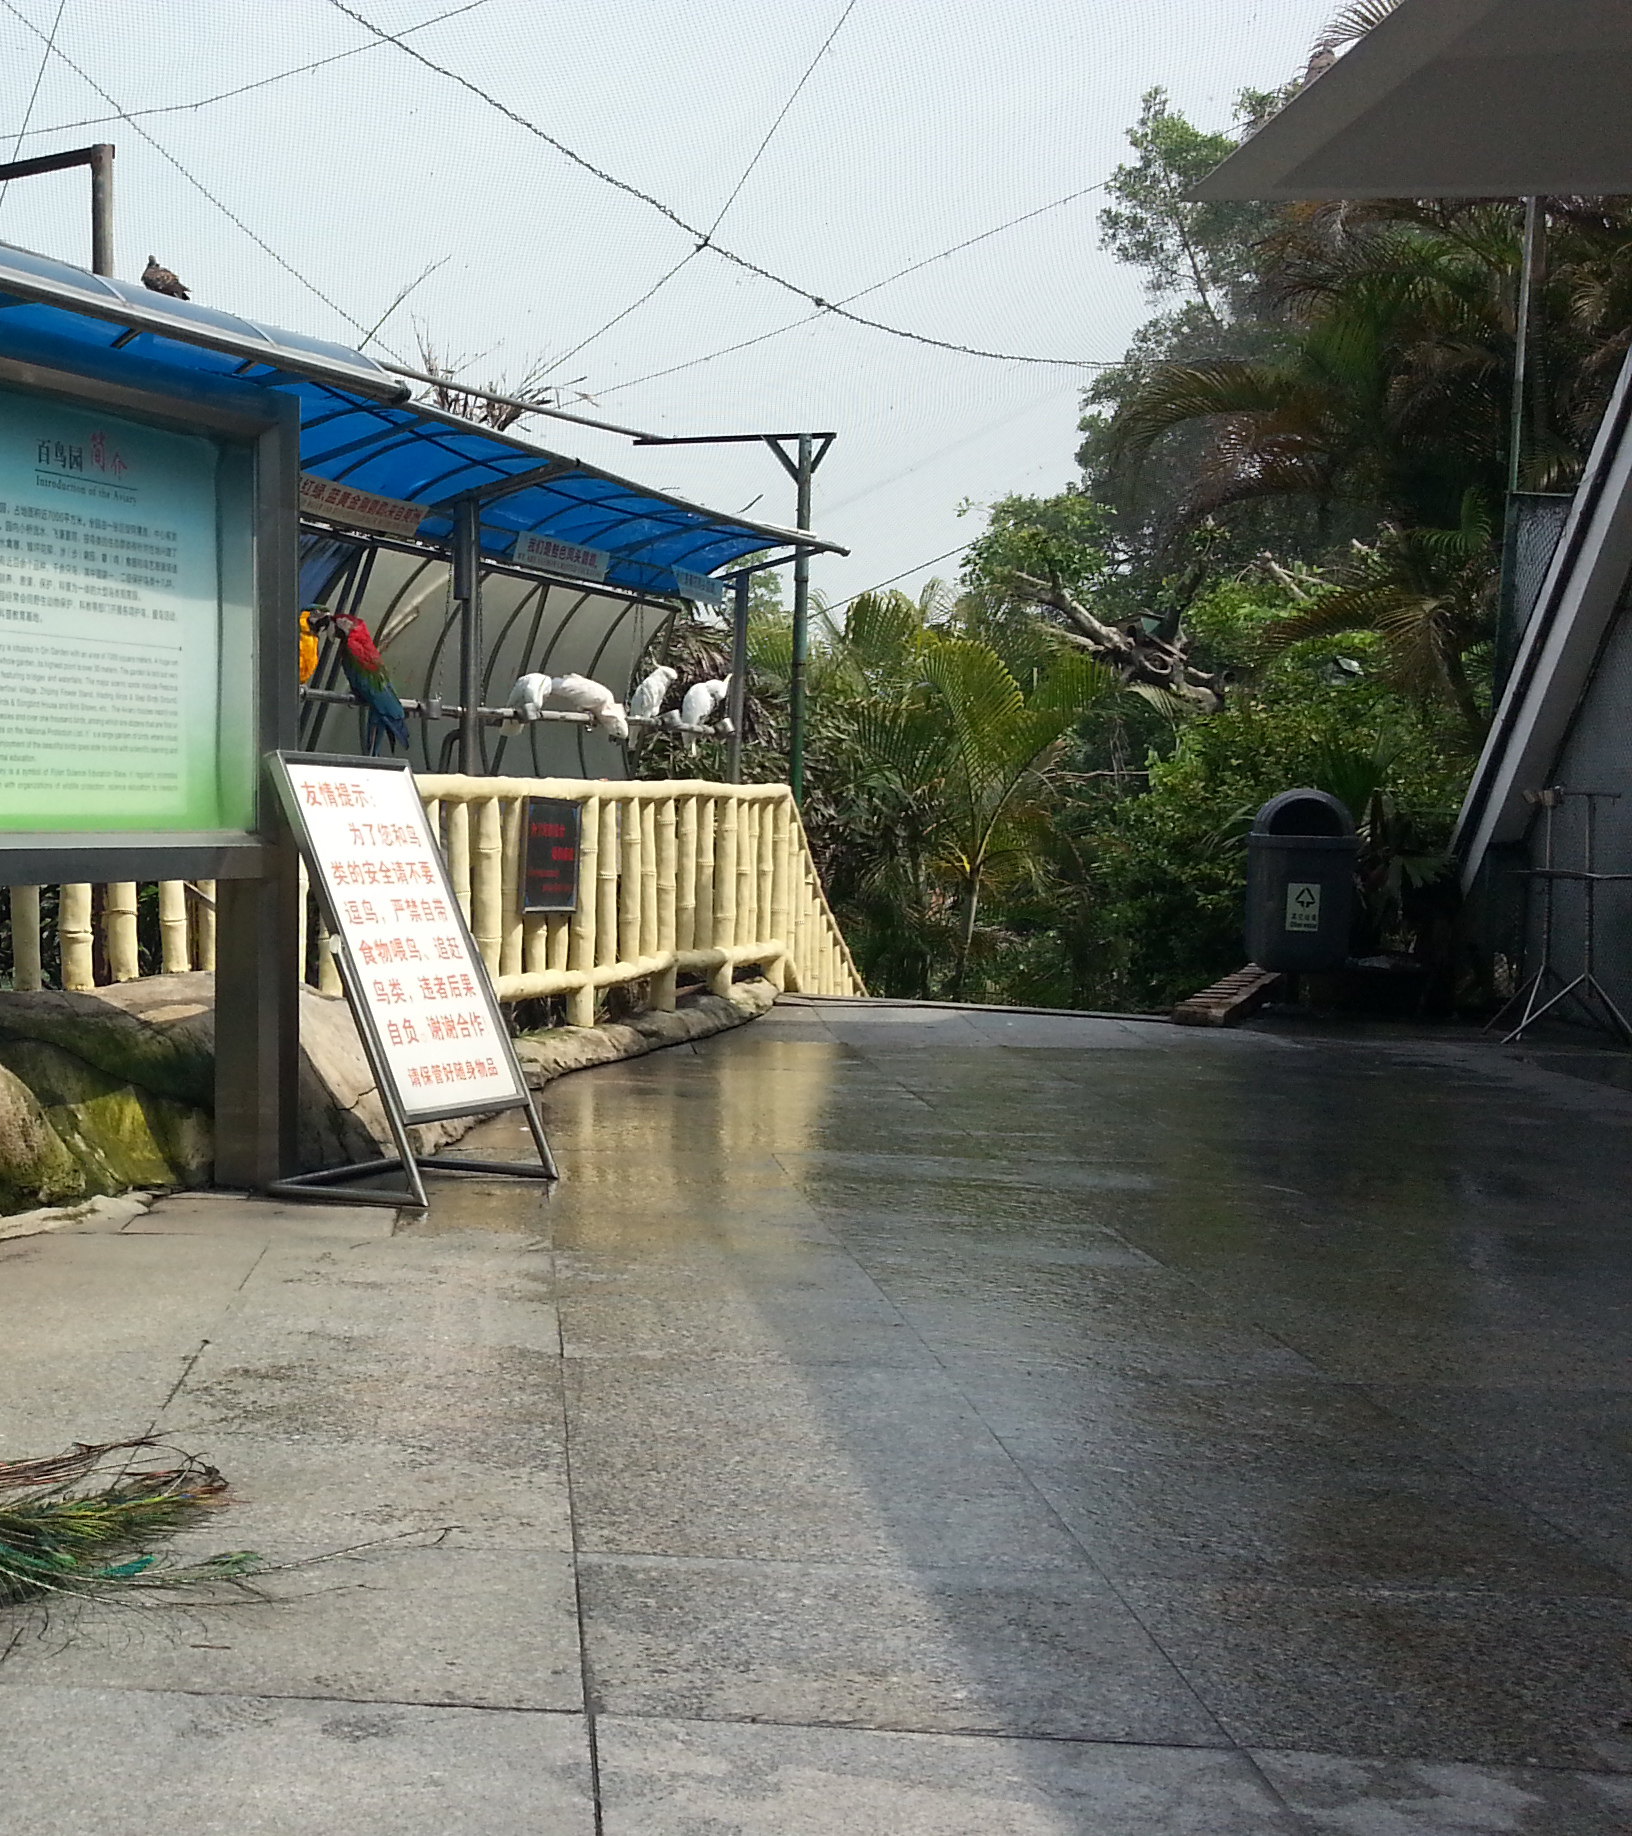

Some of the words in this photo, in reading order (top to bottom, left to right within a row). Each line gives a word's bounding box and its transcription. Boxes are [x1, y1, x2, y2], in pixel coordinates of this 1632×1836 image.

[348, 822, 422, 848] 为了您和鸟
[330, 860, 437, 886] 类的安全请不要
[408, 1057, 499, 1088] 请保管好随身物品
